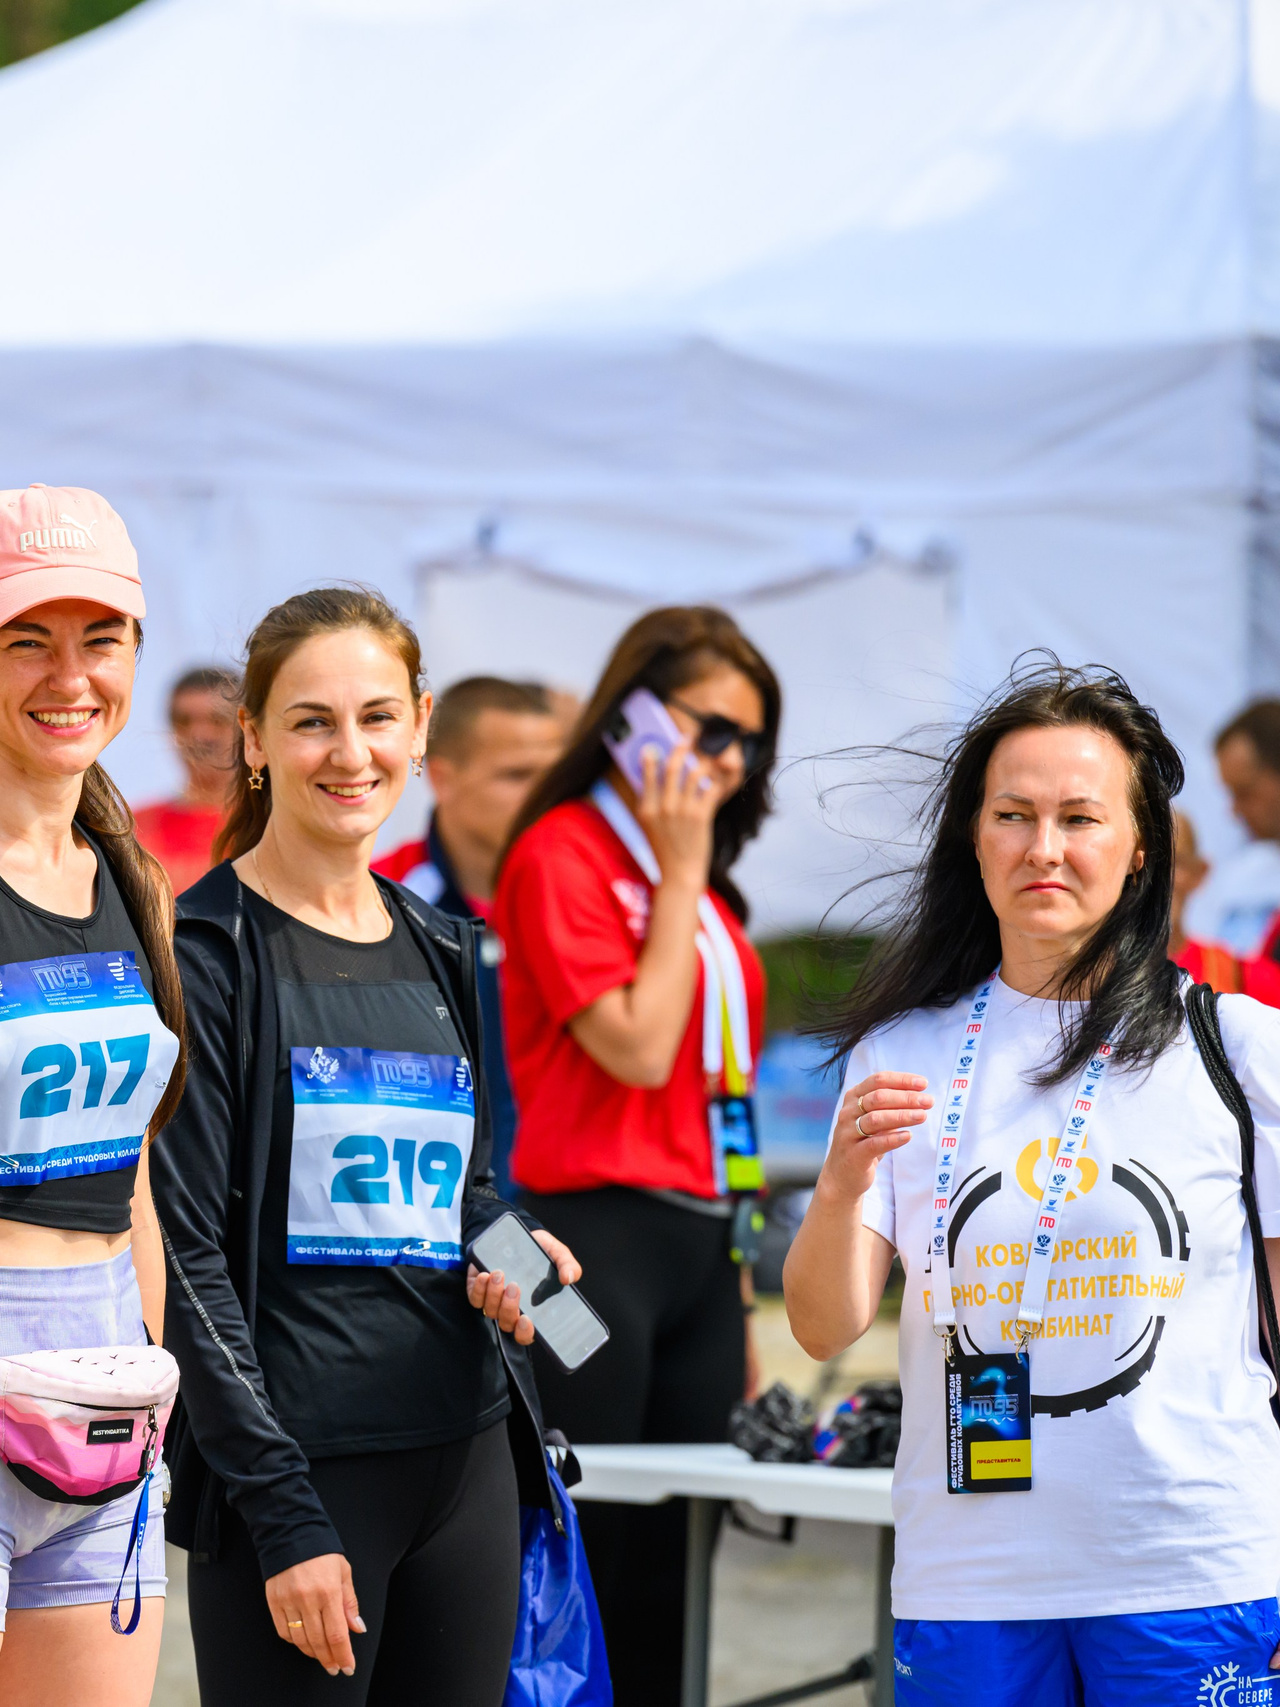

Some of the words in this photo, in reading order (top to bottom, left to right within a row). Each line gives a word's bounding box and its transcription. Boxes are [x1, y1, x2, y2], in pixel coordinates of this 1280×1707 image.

[20, 528, 86, 553] PUMA
[19, 1033, 151, 1120] 217
[46, 1155, 73, 1169] СРЕДИ
[74, 1150, 116, 1164] ТРУДОВЫХ
[331, 1134, 463, 1209] 219
[295, 1246, 363, 1257] ФЕСТИВАЛЬ
[364, 1248, 398, 1257] СРЕДИ
[950, 1427, 958, 1489] ФЕСТИВАЛЬ
[1238, 1676, 1253, 1689] НА
[1238, 1688, 1273, 1705] СЕВЕРЕ
